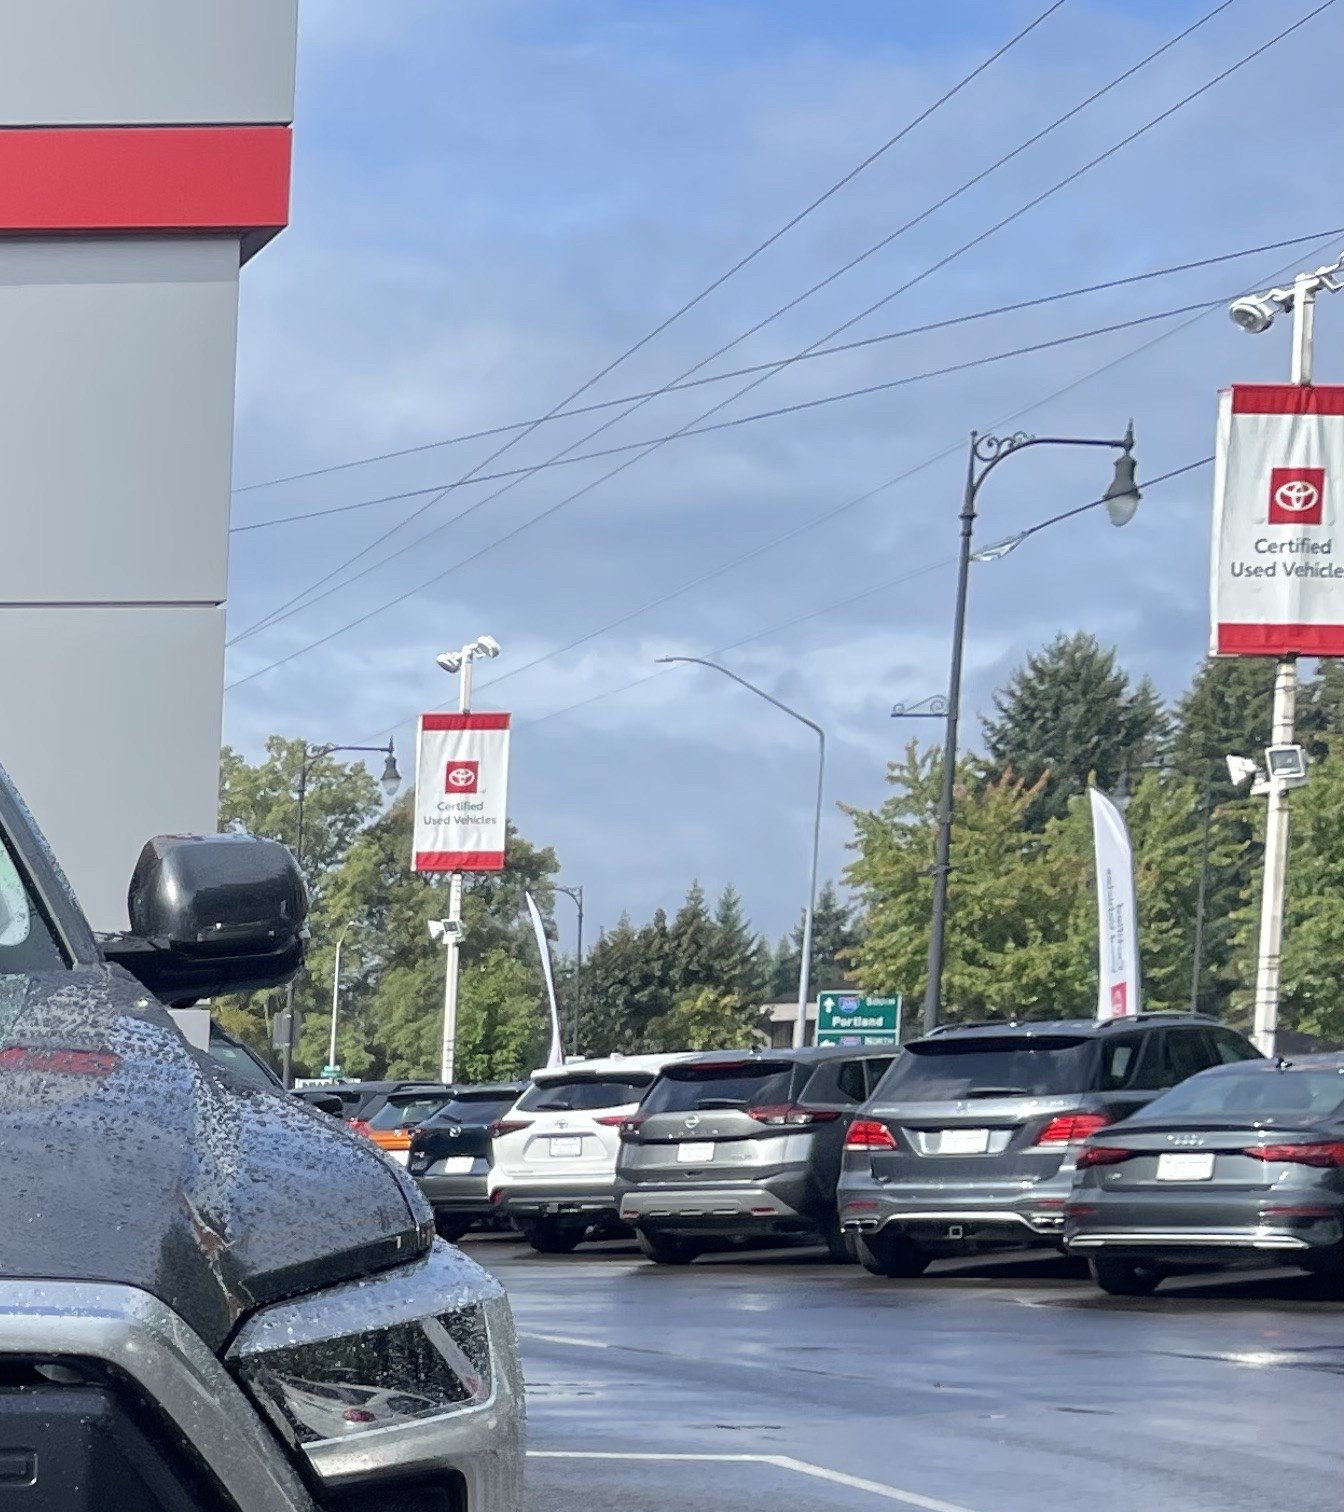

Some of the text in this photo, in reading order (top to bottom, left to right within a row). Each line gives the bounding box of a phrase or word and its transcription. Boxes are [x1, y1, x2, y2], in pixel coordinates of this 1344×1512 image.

[1254, 538, 1332, 554] Certified
[1230, 561, 1344, 578] Used Vehicle
[437, 801, 484, 811] Certified
[423, 815, 497, 825] Used Vehicles
[832, 1015, 884, 1027] Portland
